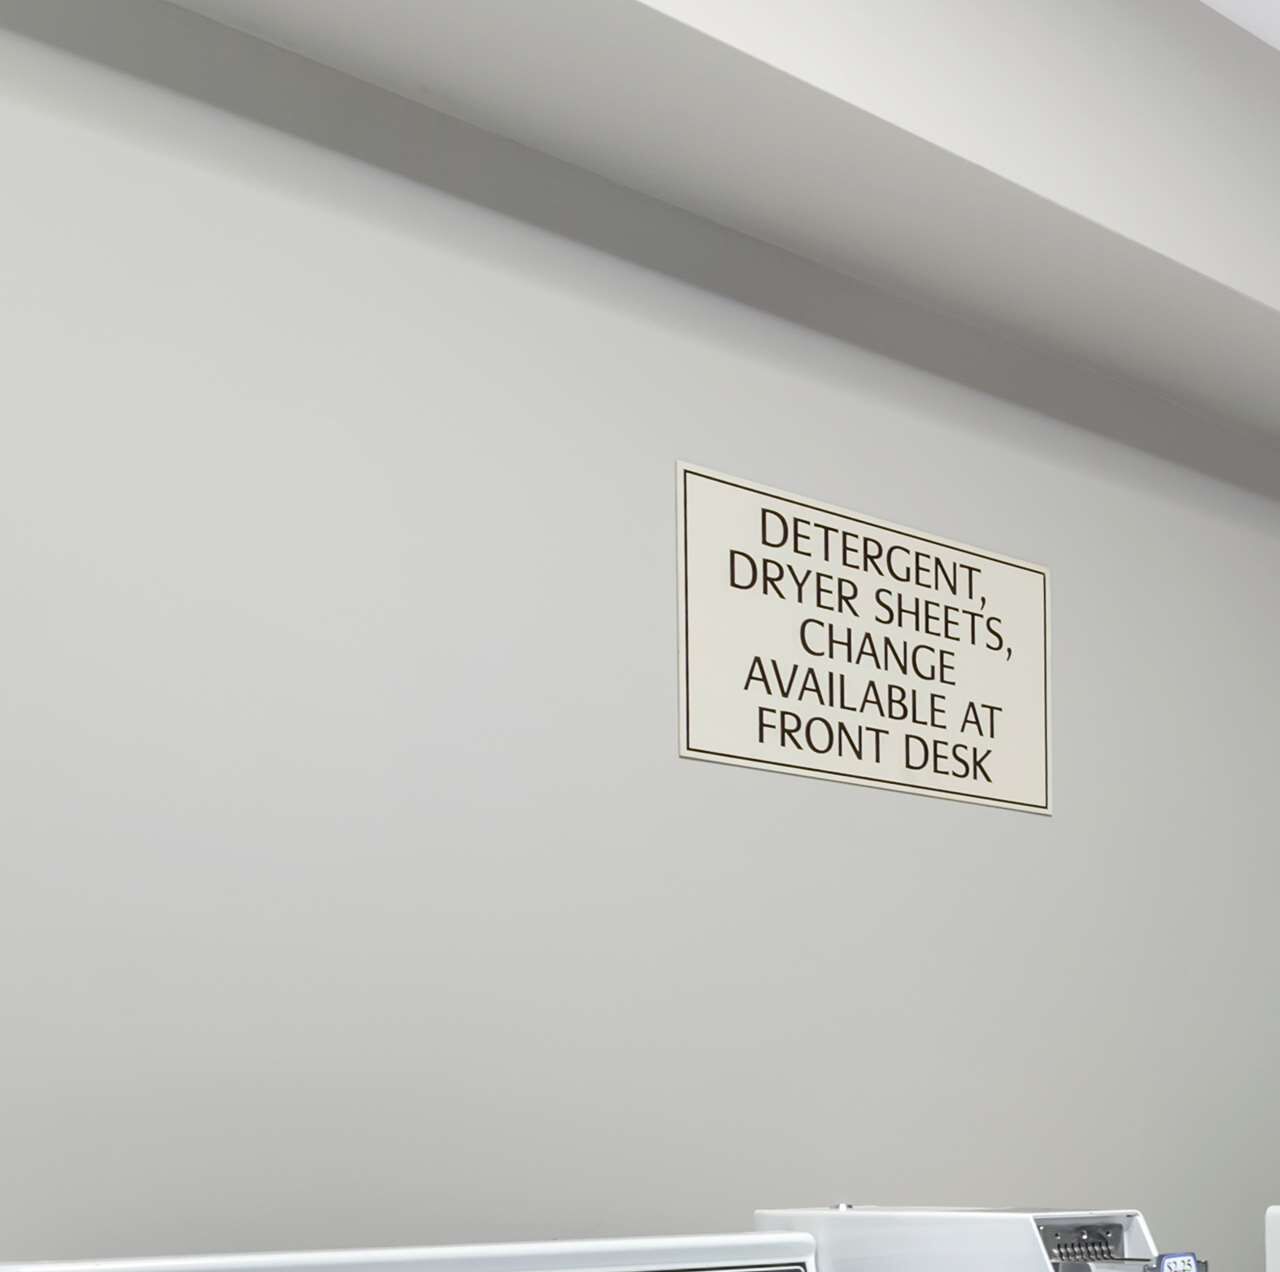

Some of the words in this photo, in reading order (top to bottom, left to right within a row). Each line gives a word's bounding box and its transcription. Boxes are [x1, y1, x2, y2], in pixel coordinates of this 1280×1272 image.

[760, 507, 987, 611] DETERGENT,
[729, 549, 860, 617] DRYER
[874, 588, 1013, 662] SHEETS,
[800, 618, 956, 686] CHANGE
[744, 656, 948, 730] AVAILABLE
[960, 701, 1003, 739] AT
[757, 706, 890, 764] FRONT
[905, 734, 993, 783] DESK
